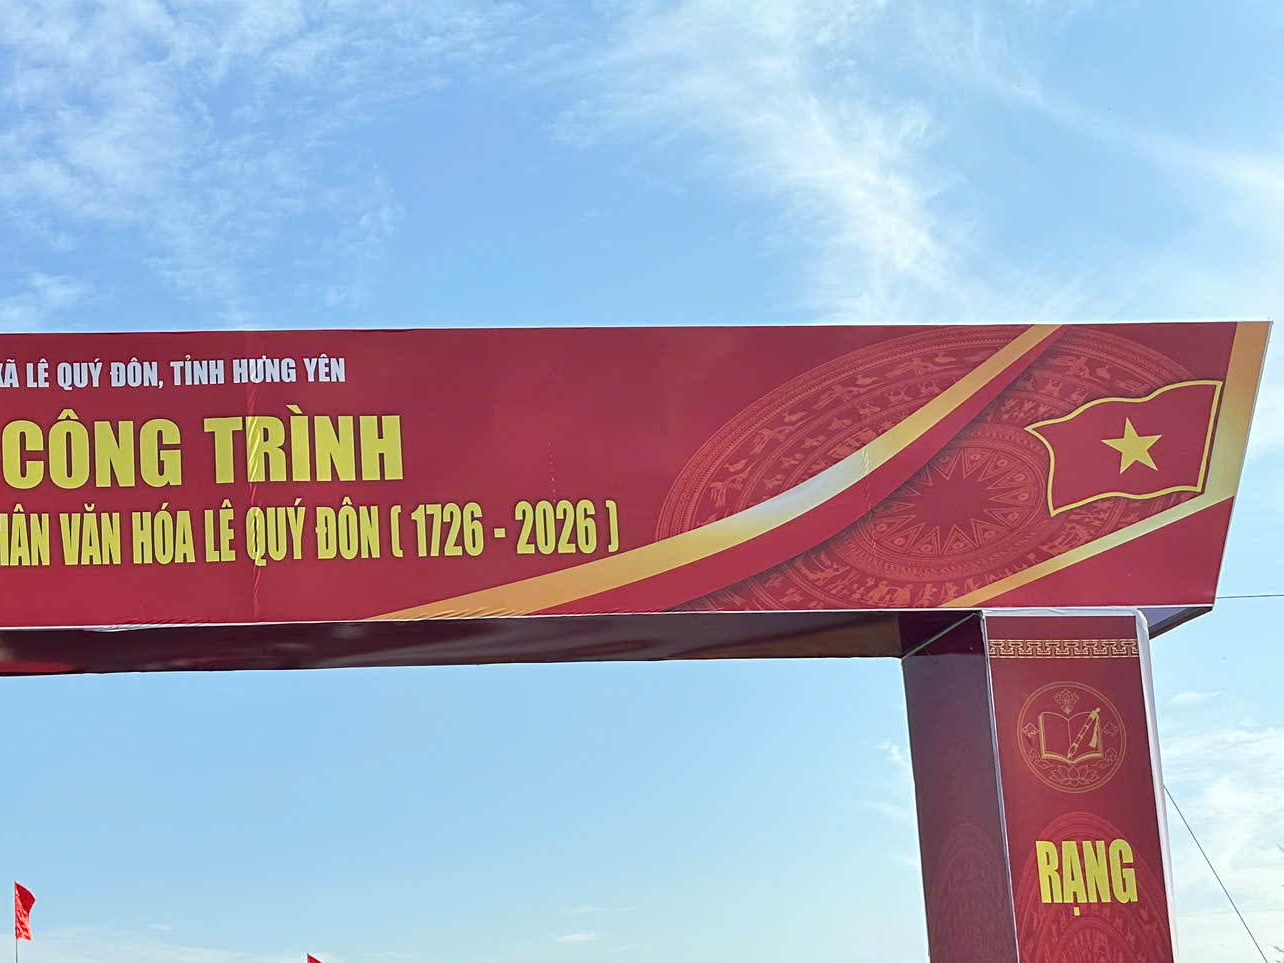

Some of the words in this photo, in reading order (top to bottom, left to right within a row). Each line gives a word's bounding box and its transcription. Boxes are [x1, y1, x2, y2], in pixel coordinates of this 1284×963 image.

[27, 359, 49, 387] LÊ
[57, 358, 102, 390] QUÝ
[110, 358, 163, 388] ĐÔN,
[170, 355, 224, 385] TỈNH
[233, 355, 296, 383] HƯNG
[303, 354, 345, 382] YÊN
[2, 409, 182, 489] CÔNG
[204, 405, 403, 483] TRÌNH
[60, 504, 121, 565] VĂN
[132, 503, 195, 564] HÓA
[205, 499, 235, 562] LÊ
[246, 498, 305, 566] QUÝ
[316, 497, 380, 559] ĐÔN
[411, 502, 484, 557] 1726
[515, 499, 597, 554] 2026
[1036, 839, 1138, 916] RẠNG
